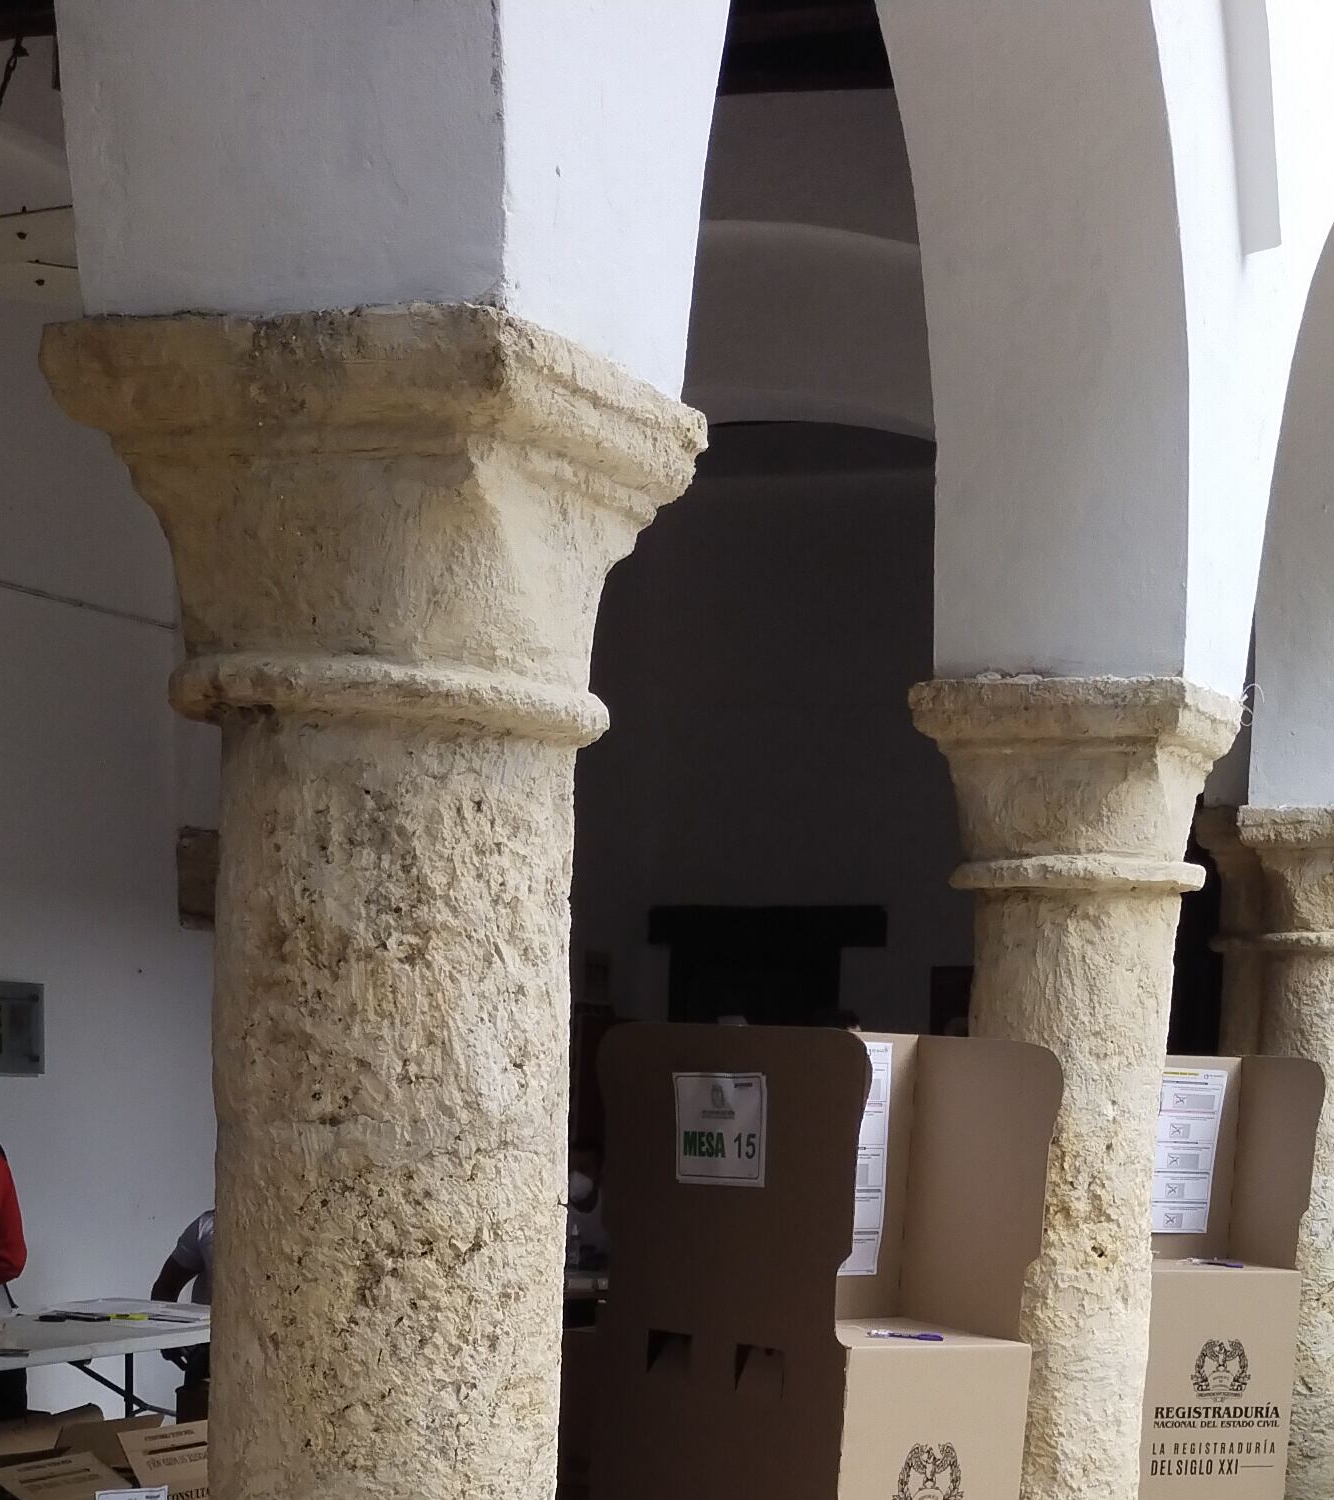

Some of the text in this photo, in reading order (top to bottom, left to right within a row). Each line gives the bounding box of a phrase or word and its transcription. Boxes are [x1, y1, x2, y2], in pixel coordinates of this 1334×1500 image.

[683, 1130, 757, 1160] MESA 15
[1154, 1402, 1280, 1419] REGISTRADURÍA
[1200, 1420, 1217, 1428] DEL
[1152, 1439, 1275, 1455] LA REGISTRADURÍA
[1151, 1460, 1239, 1476] DEL SIGLO XXI
